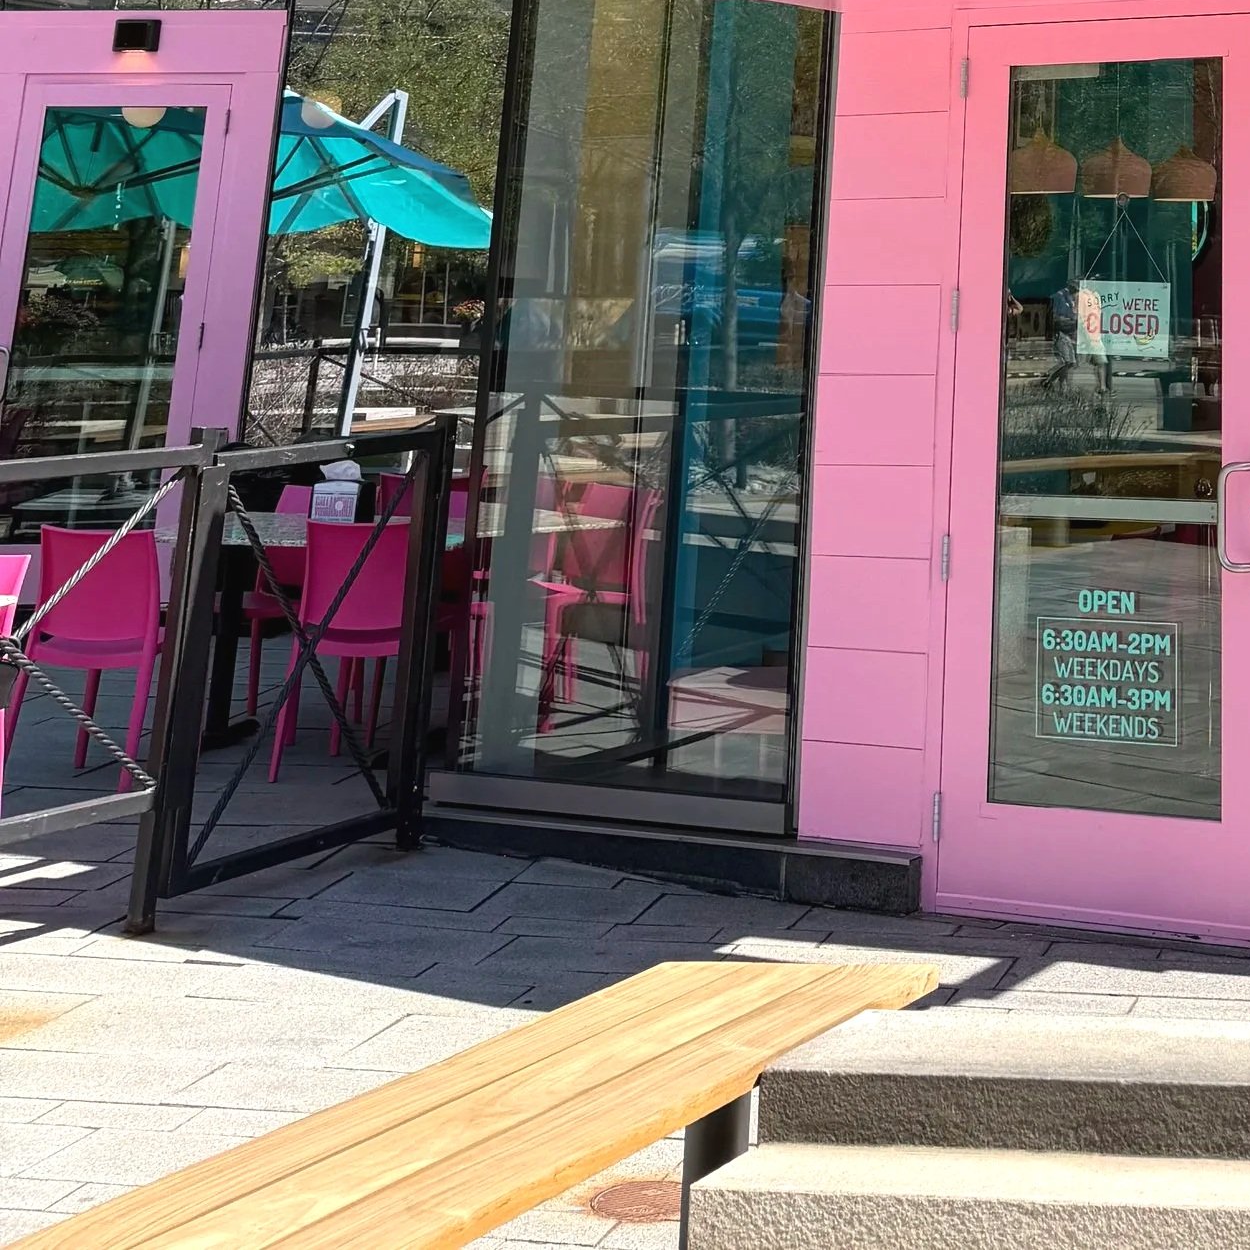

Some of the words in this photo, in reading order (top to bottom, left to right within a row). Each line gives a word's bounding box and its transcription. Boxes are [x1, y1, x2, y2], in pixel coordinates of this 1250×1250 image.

[1122, 298, 1160, 312] WE'RE
[1086, 313, 1160, 336] CLOSED
[1079, 589, 1135, 614] OPEN
[1042, 629, 1171, 656] 6:30AM-2PM
[1053, 657, 1160, 683] WEEKDAYS
[1041, 684, 1171, 712] 6:30AM-3PM
[1052, 713, 1160, 739] WEEKENDS
